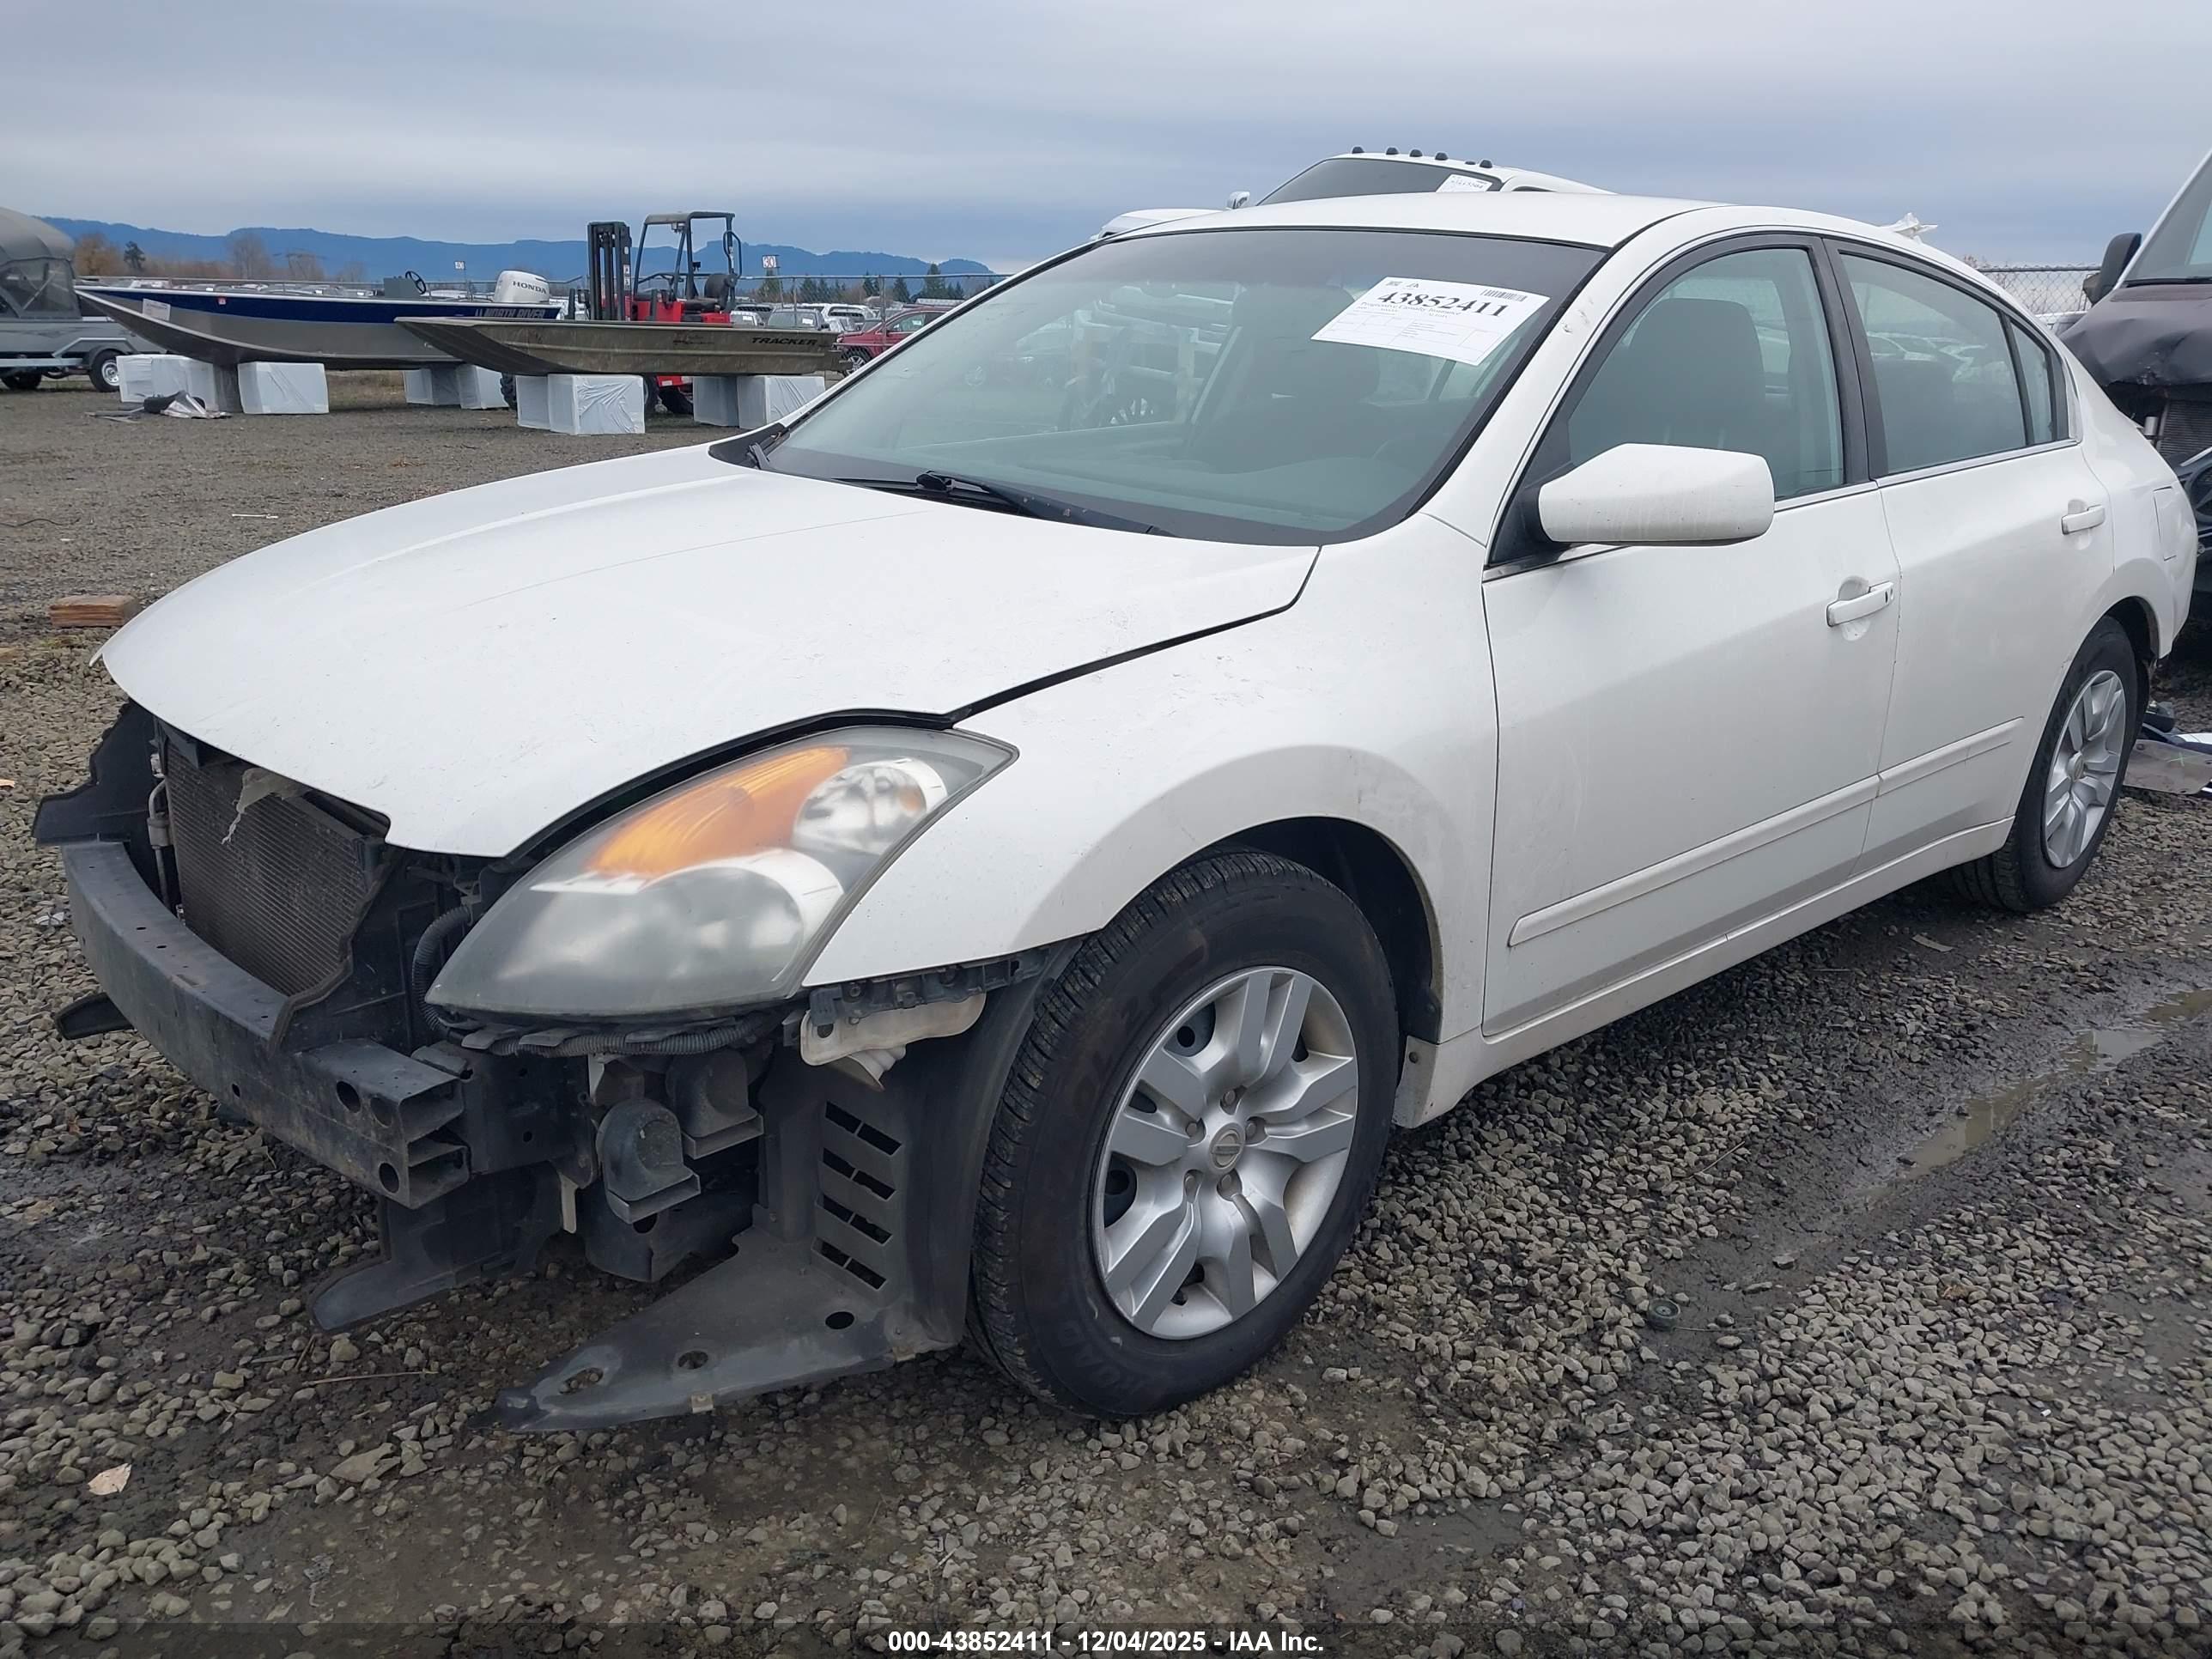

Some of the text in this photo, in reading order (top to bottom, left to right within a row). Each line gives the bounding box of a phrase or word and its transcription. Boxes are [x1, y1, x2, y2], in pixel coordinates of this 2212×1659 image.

[513, 281, 547, 294] HONDA
[1376, 291, 1510, 318] 43852411
[483, 308, 516, 318] NORTH
[751, 336, 818, 346] TRACKER
